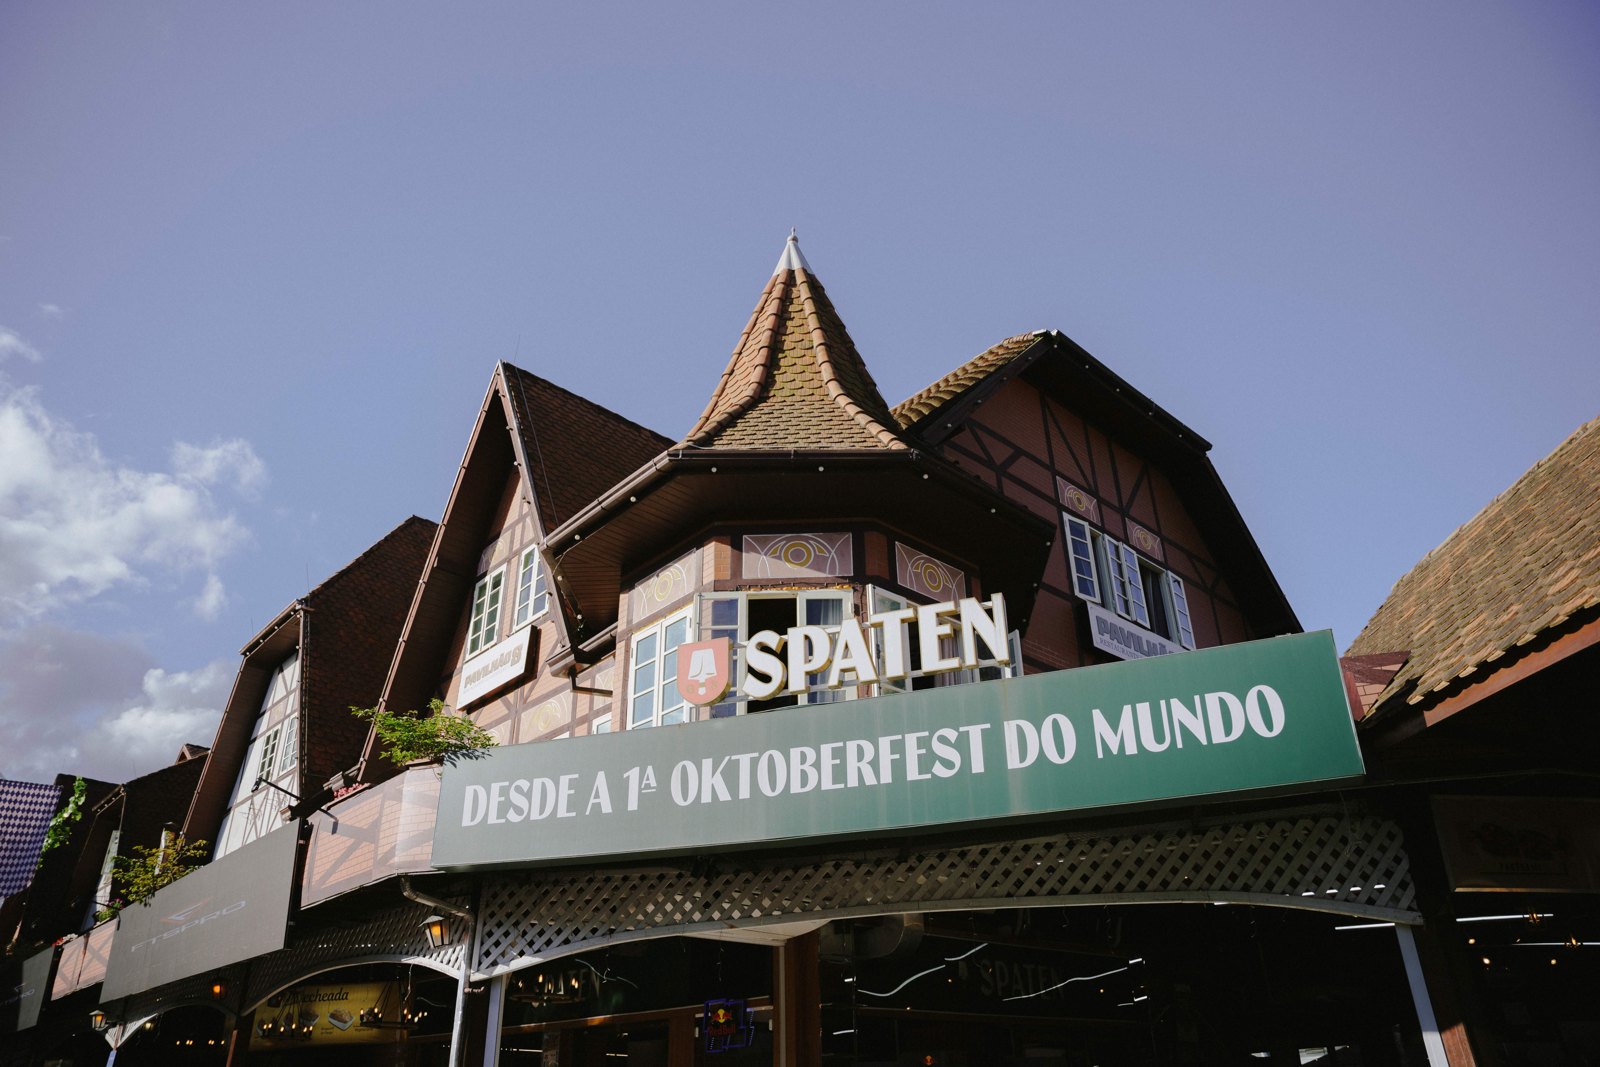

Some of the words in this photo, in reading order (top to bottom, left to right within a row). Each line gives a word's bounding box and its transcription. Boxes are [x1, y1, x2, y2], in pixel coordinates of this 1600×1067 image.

[742, 592, 1010, 700] SPATEN
[462, 774, 579, 827] DESDE
[585, 771, 613, 815] A
[670, 723, 991, 807] OKTOBERFEST
[1003, 713, 1077, 769] DO
[1092, 684, 1286, 759] MUNDO
